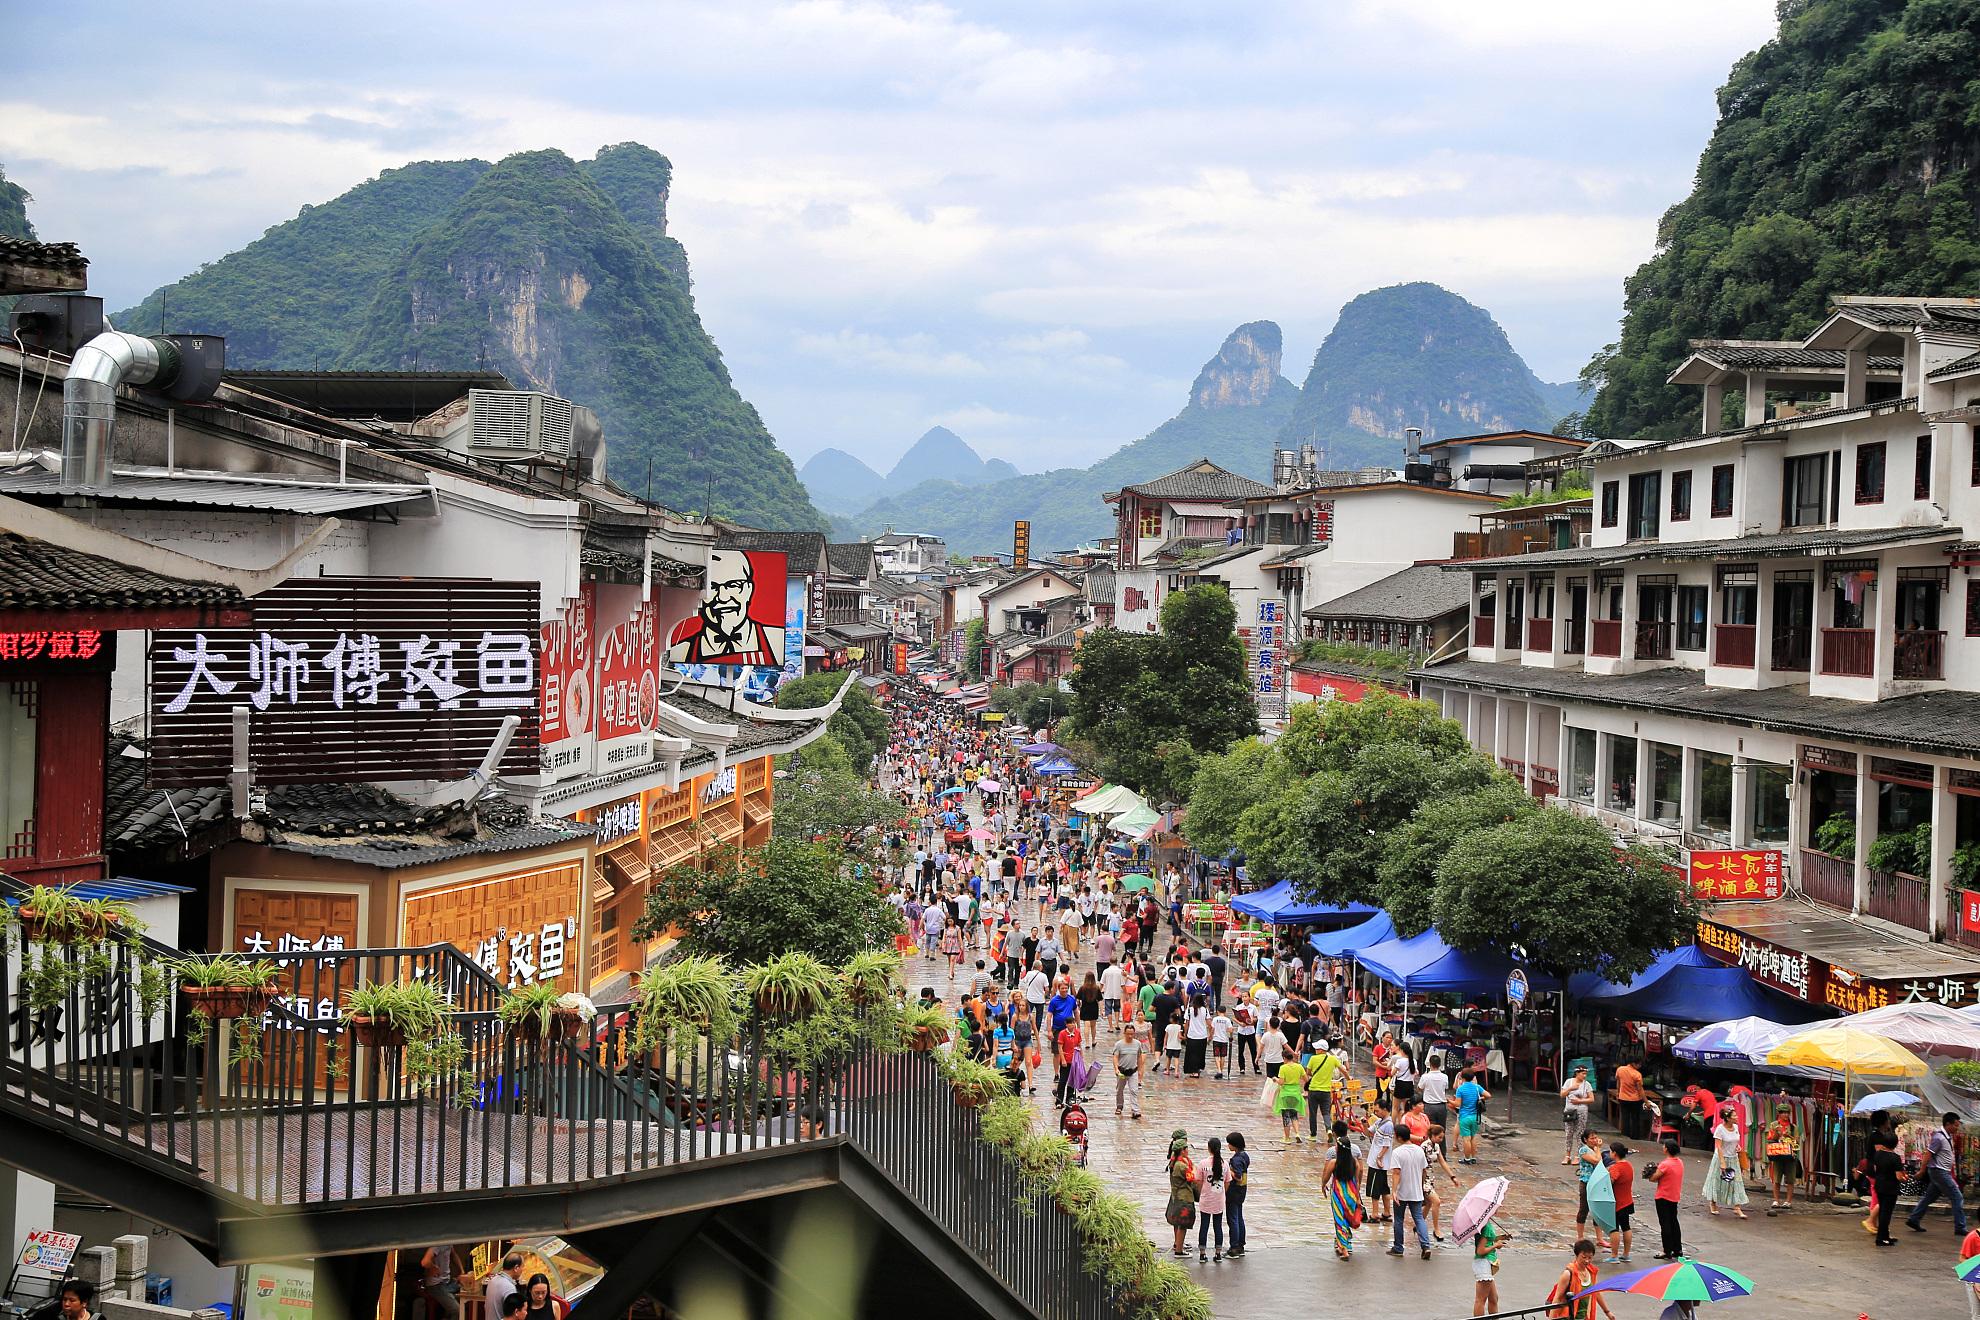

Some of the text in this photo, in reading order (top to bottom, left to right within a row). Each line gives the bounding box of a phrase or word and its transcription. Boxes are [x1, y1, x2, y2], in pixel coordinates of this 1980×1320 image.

[813, 584, 824, 618] 西街酒店
[602, 677, 638, 733] 啤酒鱼
[1695, 876, 1762, 897] 啤酒鱼
[1763, 852, 1779, 897] 停车用餐
[1696, 922, 1741, 958] 啤酒鱼王金奖
[1737, 937, 1801, 988] 大师傅啤酒鱼
[1800, 952, 1809, 1000] 老店
